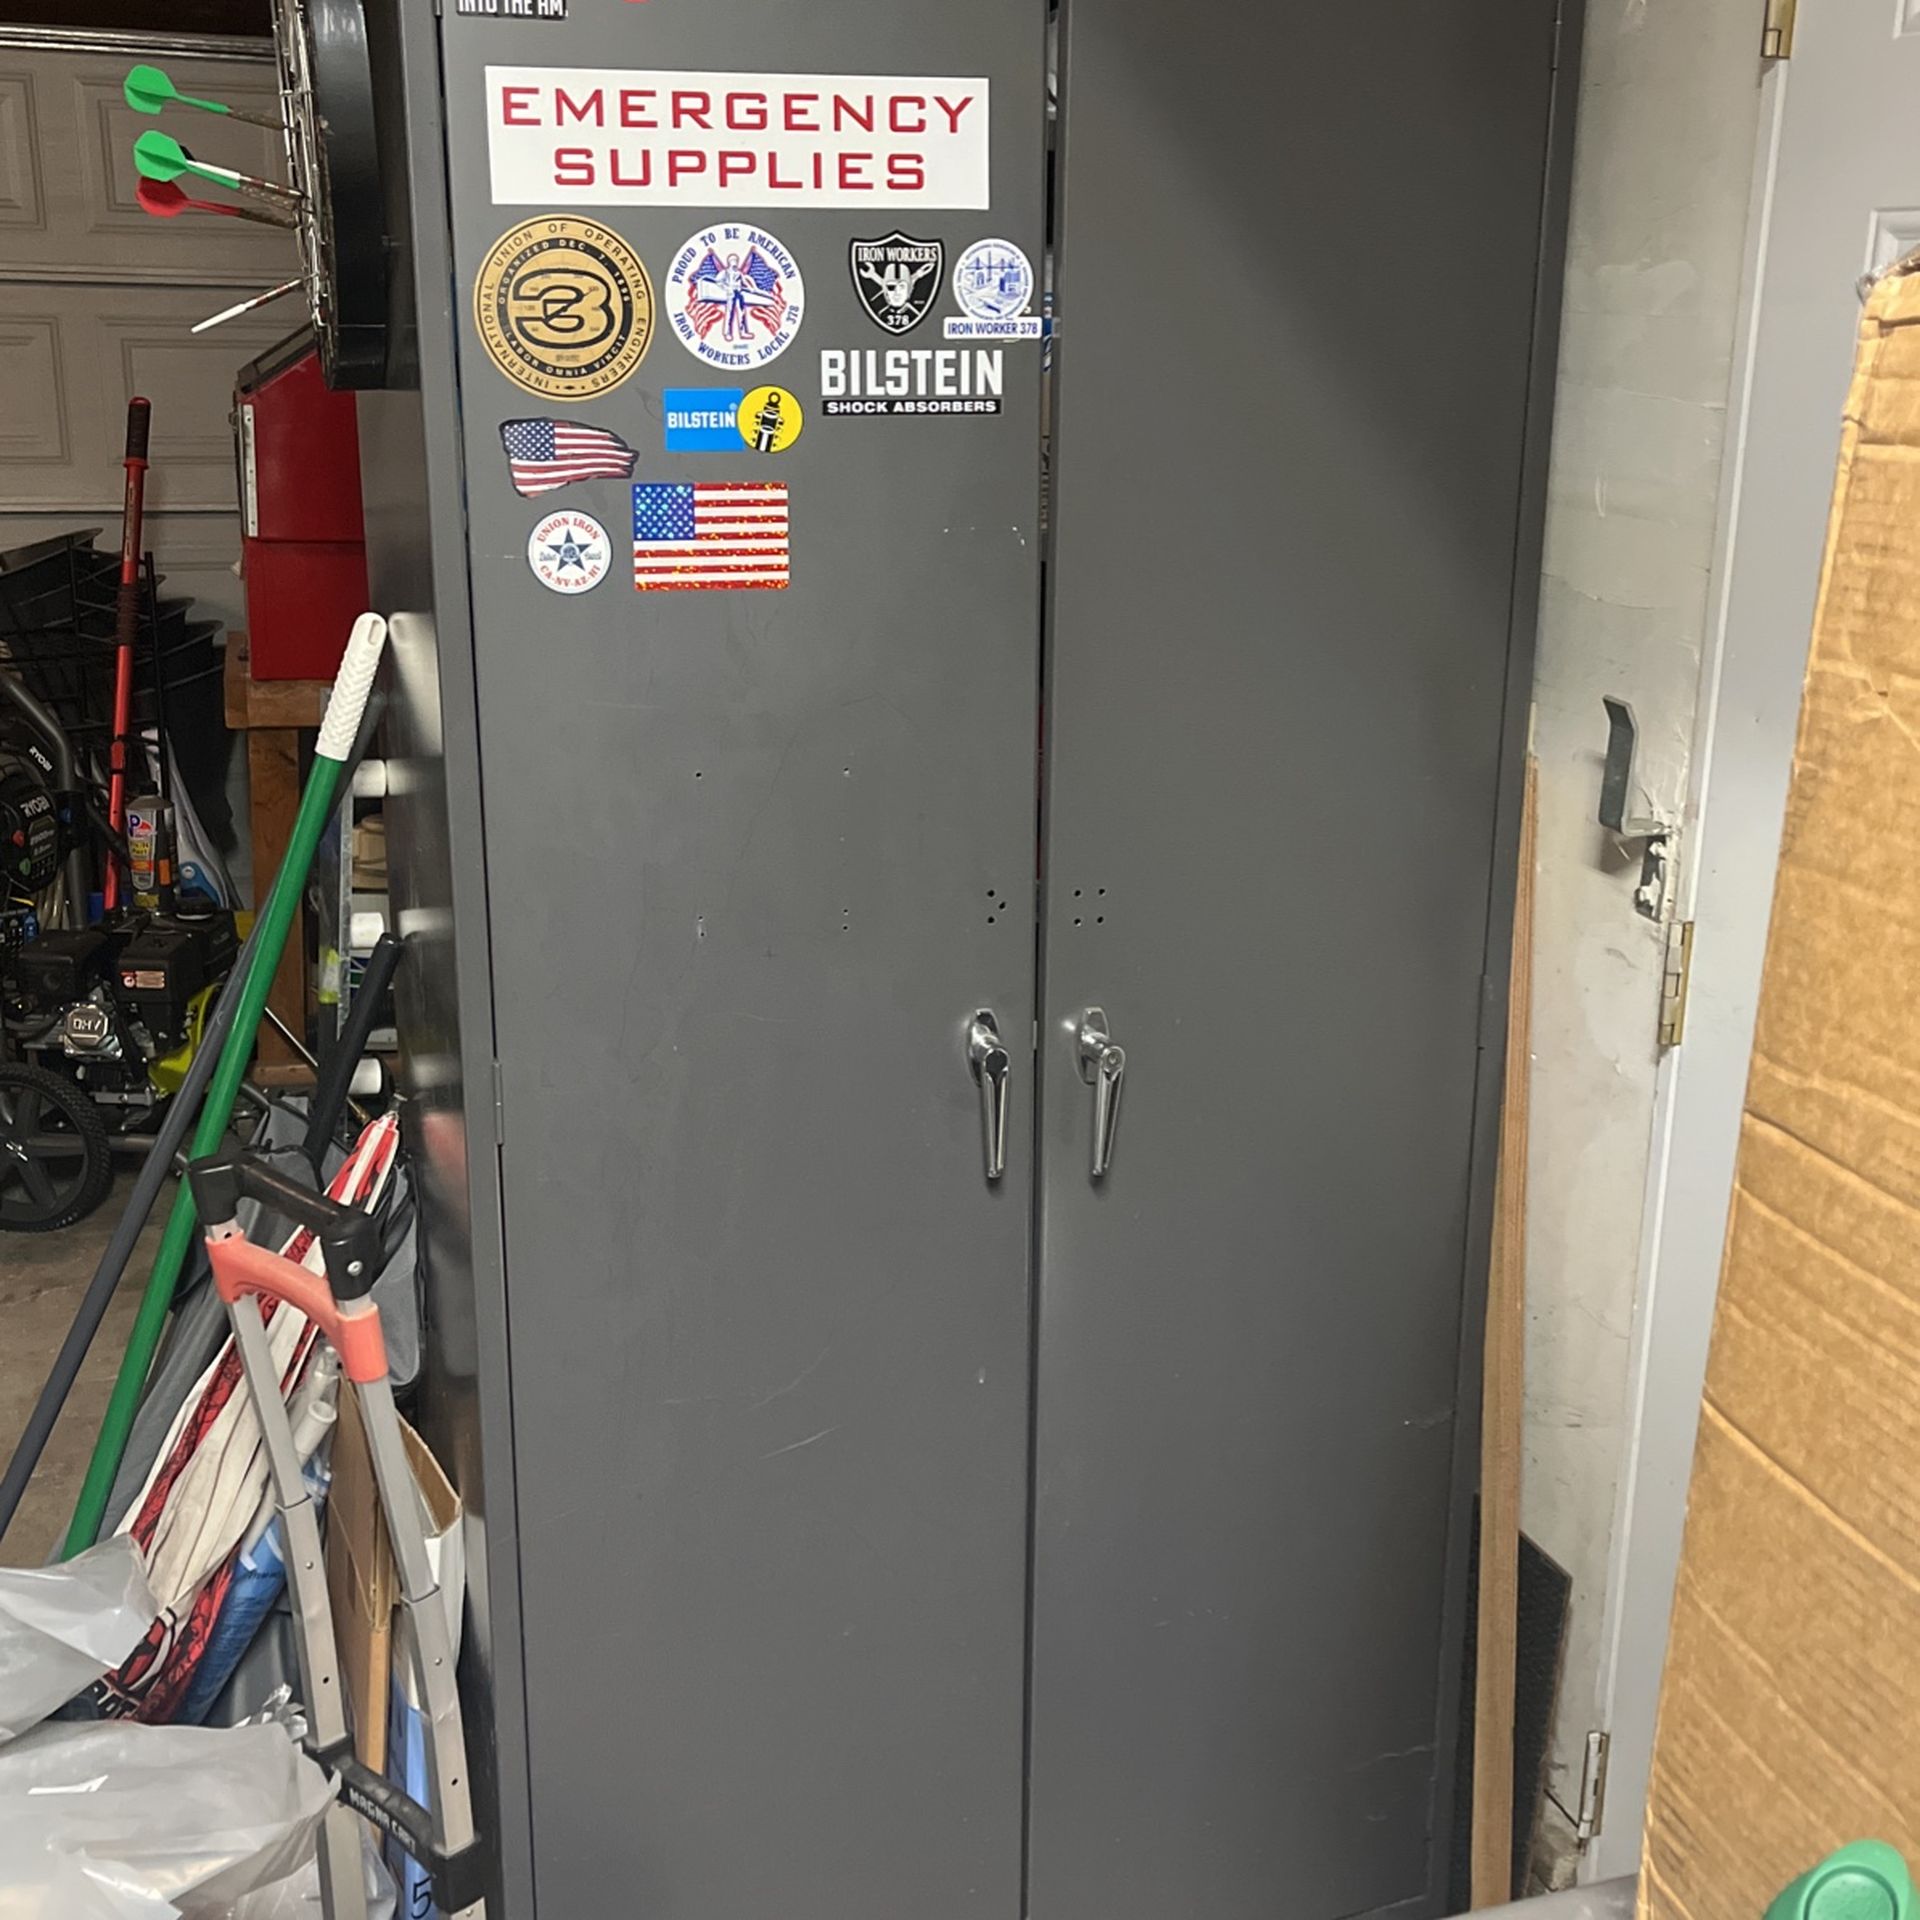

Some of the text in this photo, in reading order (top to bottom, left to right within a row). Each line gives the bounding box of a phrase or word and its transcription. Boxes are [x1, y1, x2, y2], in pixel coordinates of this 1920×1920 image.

[504, 0, 533, 14] THE
[502, 86, 974, 134] EMERGENCY
[554, 147, 925, 191] SUPPLIES
[499, 239, 550, 305] ORGANIZED
[672, 228, 796, 284] PROUD TO BE AMERICAN
[858, 247, 937, 262] IRON WORKERS
[483, 223, 647, 389] INTERNATIONAL UNION OF OPERATING ENGINEERS
[886, 315, 910, 326] 378
[673, 305, 800, 365] IRON WORKERS LOCAL 378
[948, 323, 1038, 335] IRON WORKER 378
[506, 332, 626, 378] LABOR OMNIA VINCIT
[821, 350, 1003, 396] BILSTEIN
[667, 411, 736, 429] BILSTEIN
[827, 401, 996, 414] SHOCK ABSORBERS
[537, 517, 600, 543] UNION IRON
[349, 1787, 416, 1854] MAGNA CART
